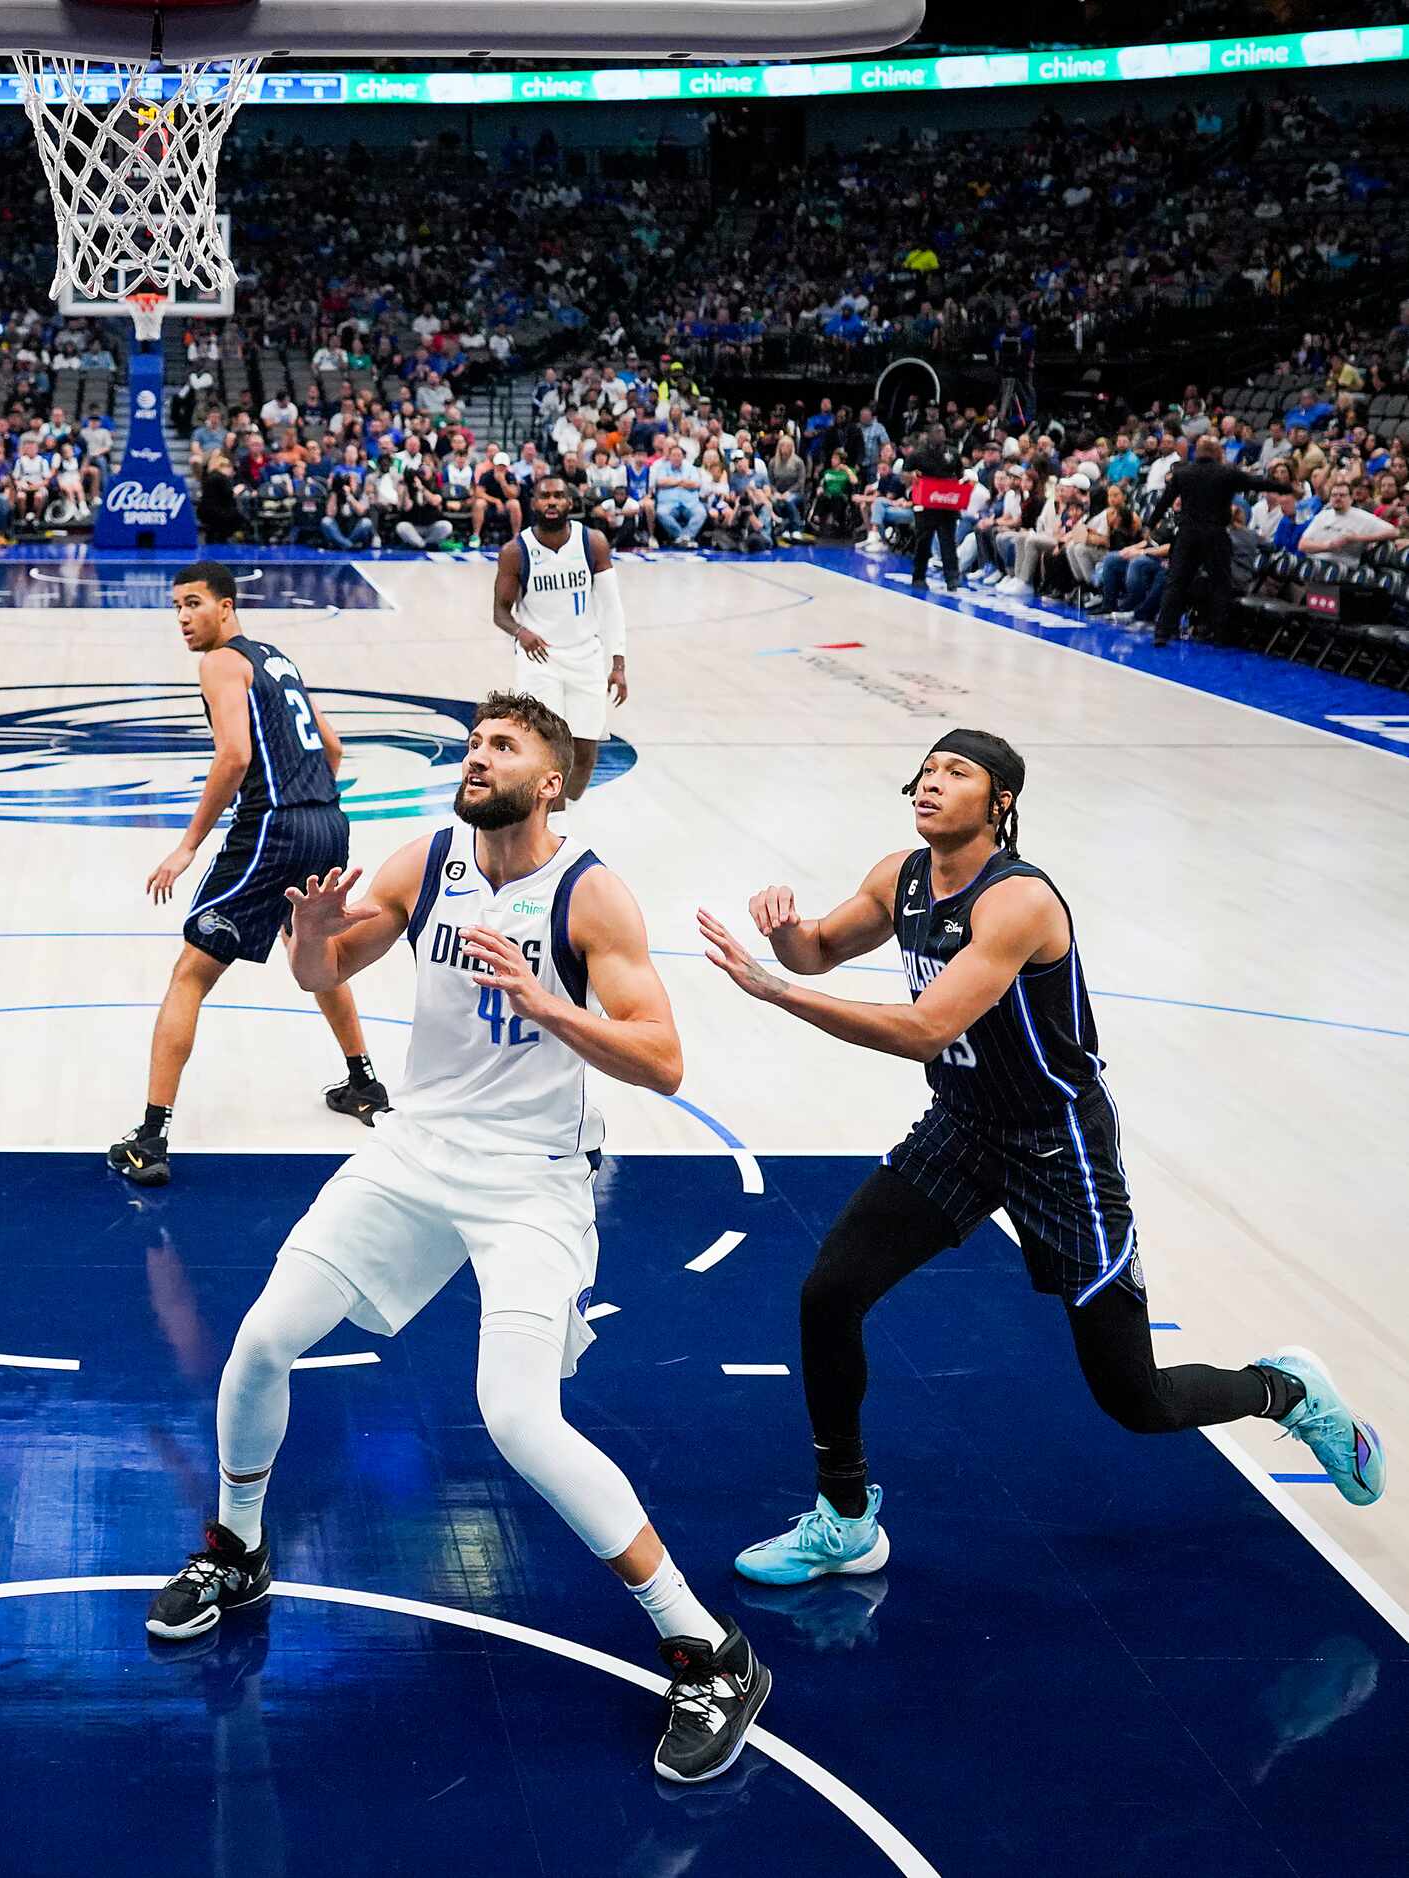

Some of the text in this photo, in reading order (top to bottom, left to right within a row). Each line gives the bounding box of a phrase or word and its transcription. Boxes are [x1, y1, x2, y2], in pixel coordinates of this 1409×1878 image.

[1221, 42, 1288, 67] chime
[861, 64, 925, 88] chime
[1039, 55, 1106, 79] chime
[356, 77, 419, 99] chime
[521, 76, 585, 98] chime
[689, 71, 753, 94] chime
[107, 481, 186, 519] Bally
[533, 570, 587, 592] DALLAS
[573, 590, 586, 616] 11
[284, 689, 324, 750] 2
[448, 863, 465, 879] 6
[908, 879, 919, 896] 6
